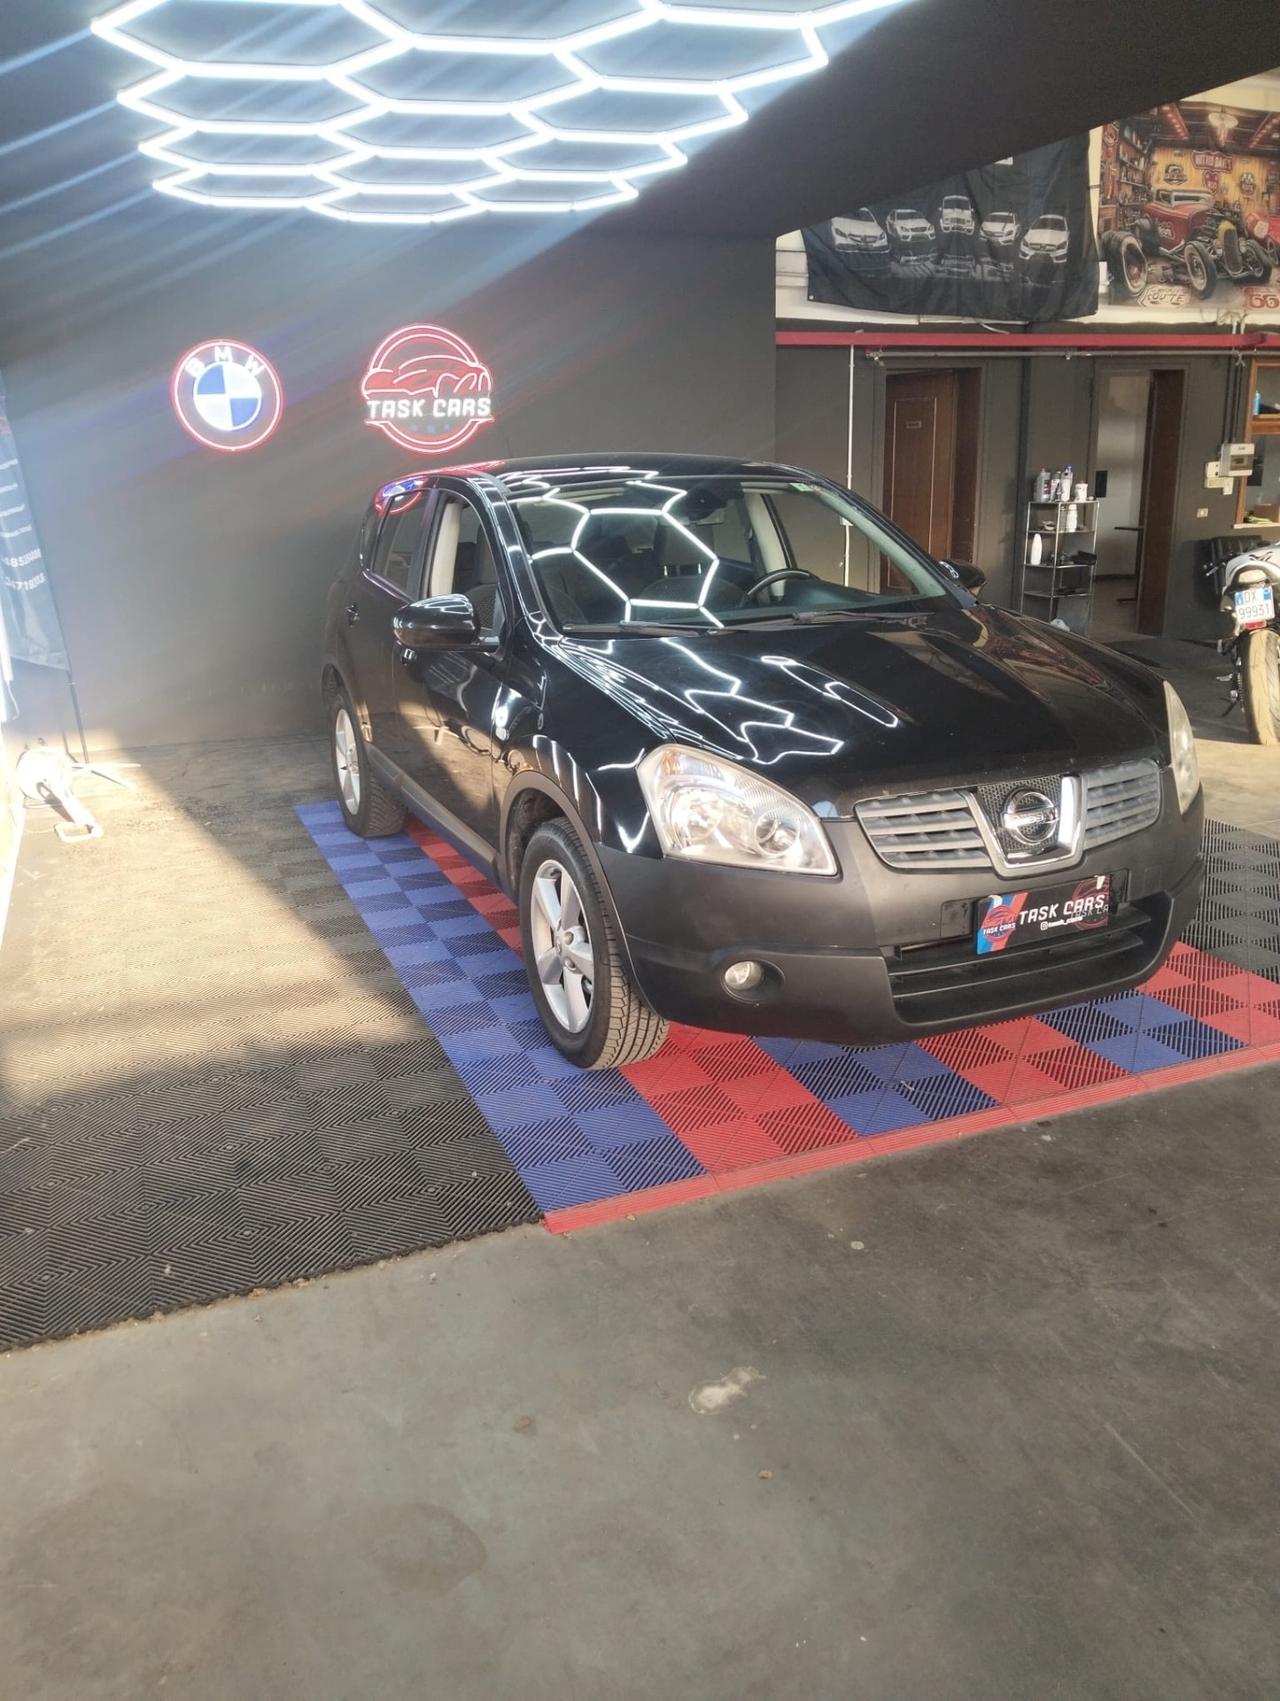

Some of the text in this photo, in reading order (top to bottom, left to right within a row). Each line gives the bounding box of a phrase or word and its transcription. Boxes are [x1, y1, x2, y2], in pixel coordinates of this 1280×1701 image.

[1249, 294, 1280, 309] 66
[185, 346, 265, 378] BMW
[367, 397, 491, 418] TASK CARS
[1019, 894, 1106, 925] TASK CARS
